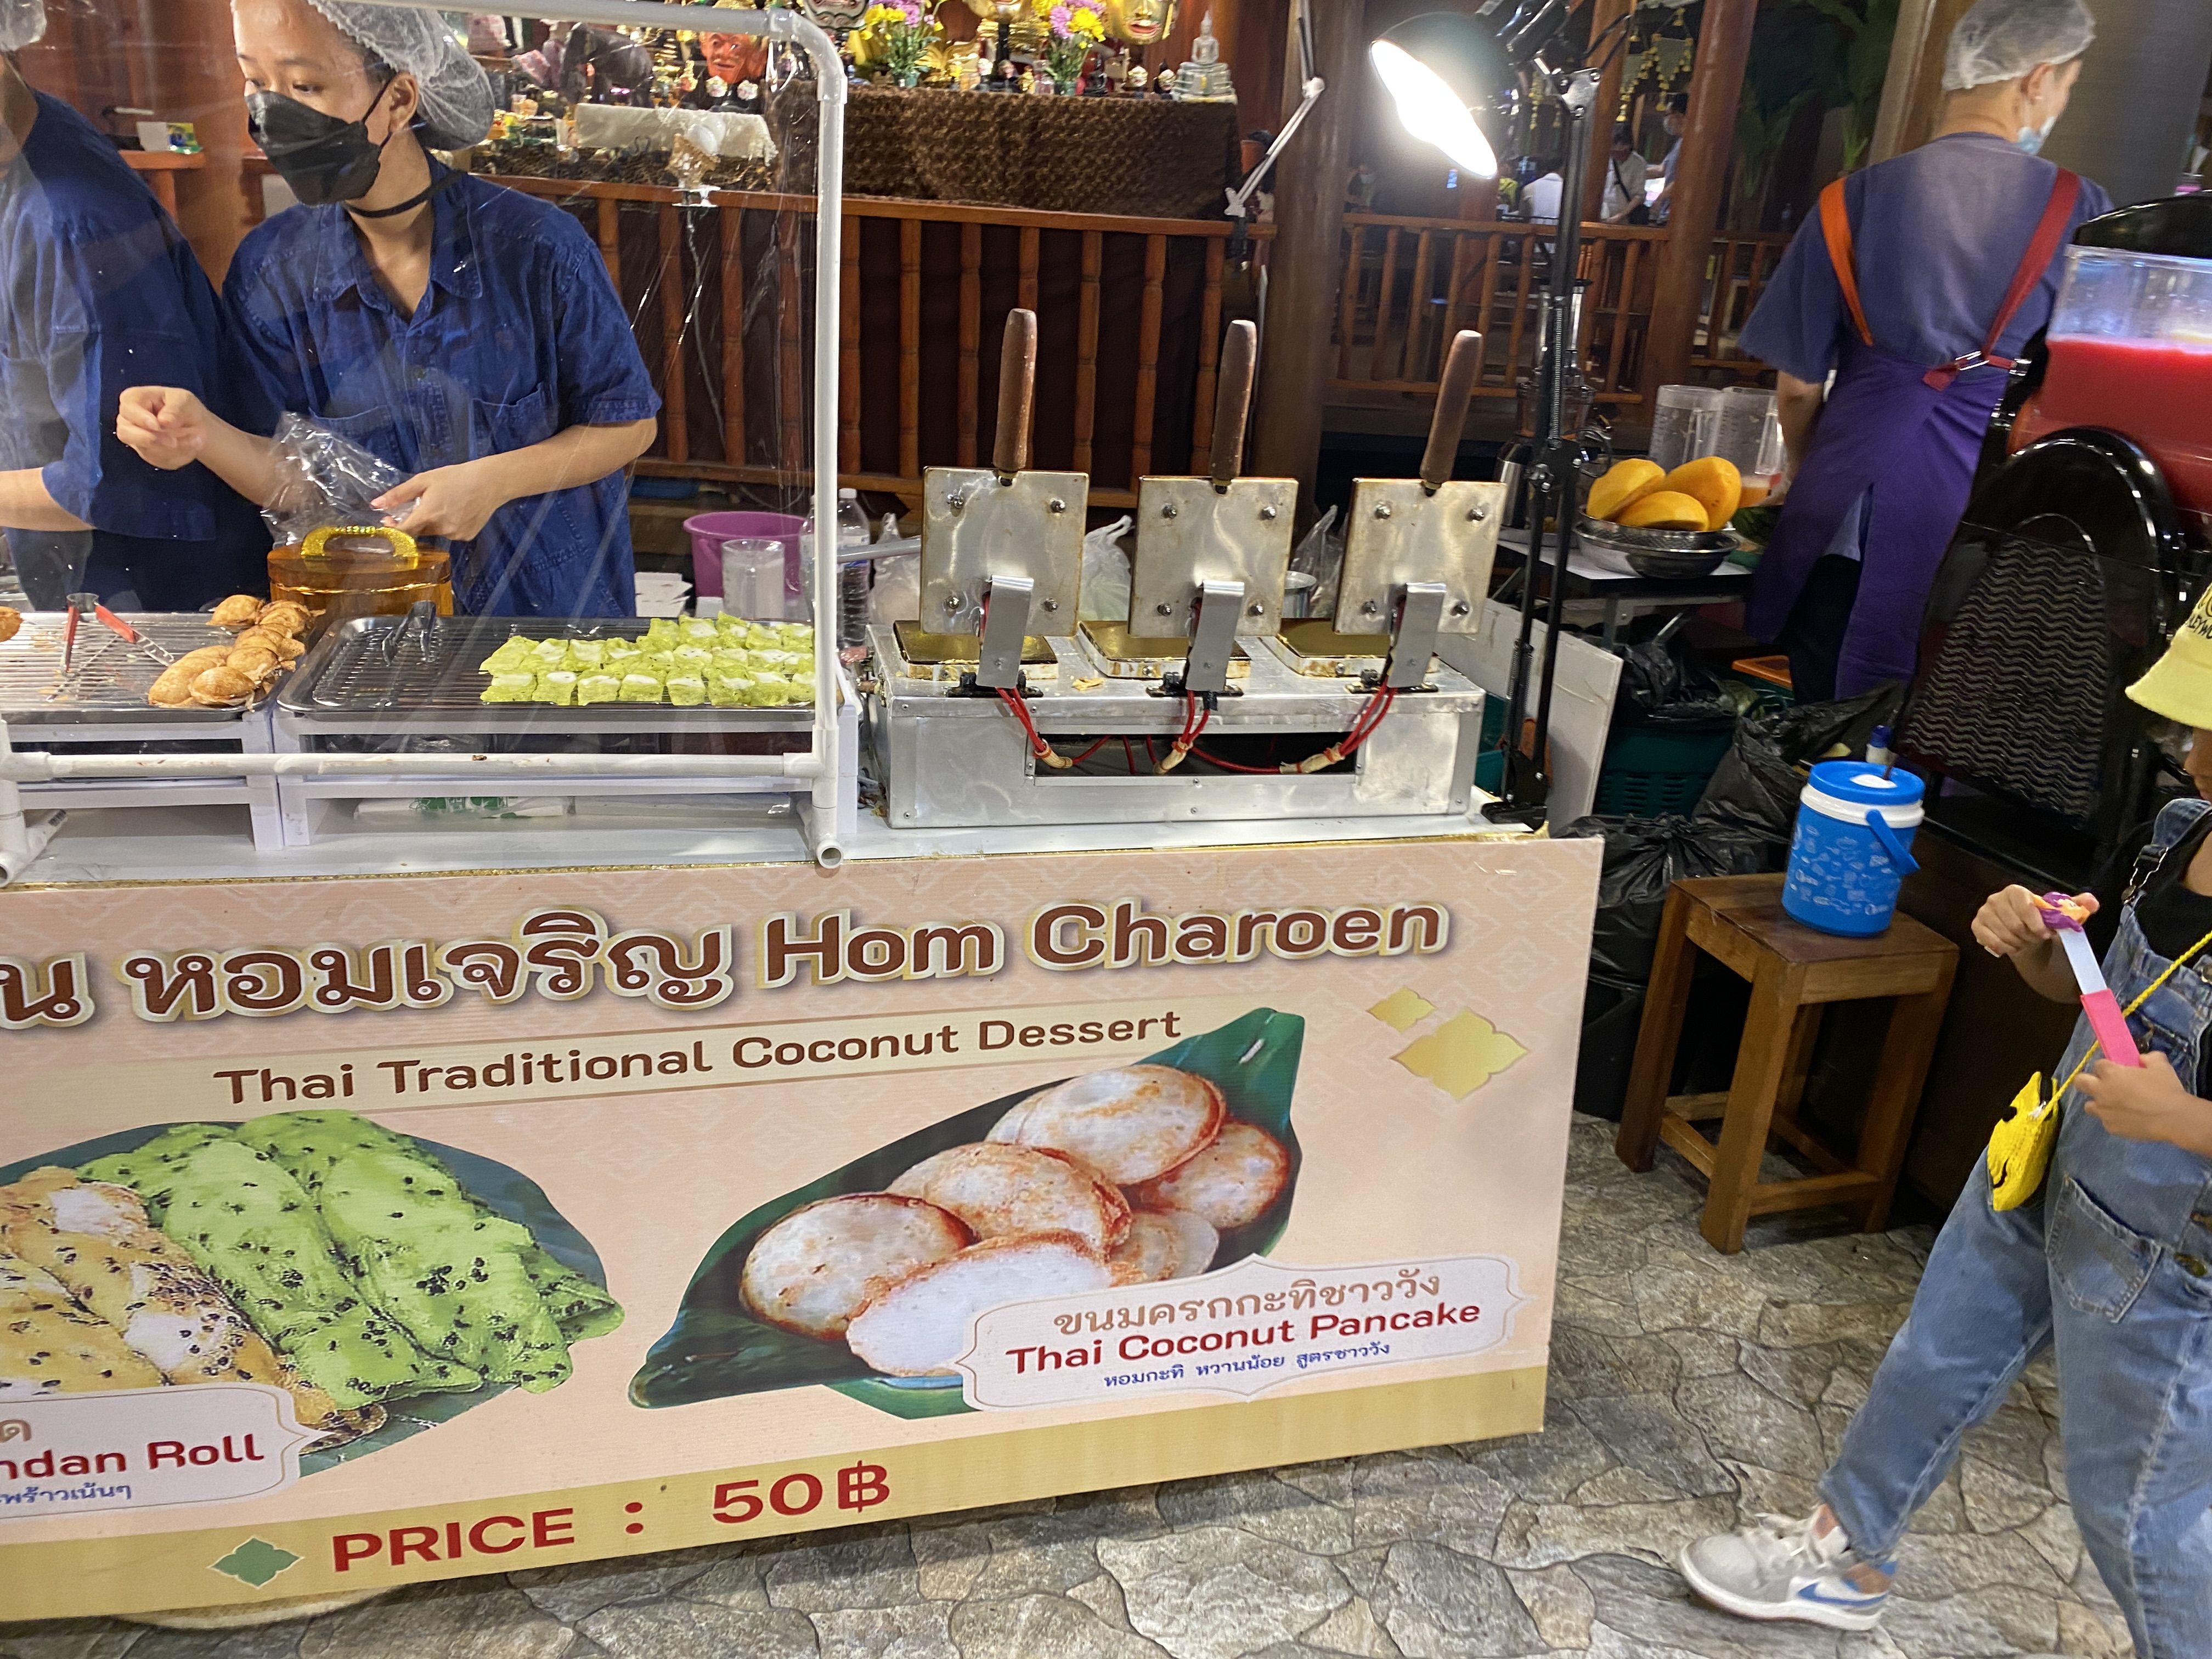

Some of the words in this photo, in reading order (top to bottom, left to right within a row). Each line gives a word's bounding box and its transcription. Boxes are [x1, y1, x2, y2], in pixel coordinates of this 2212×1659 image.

[122, 908, 726, 1018] หอมเจริญ
[764, 912, 998, 985] Hom
[1030, 900, 1443, 967] Charoen
[212, 1063, 354, 1105] Thai
[376, 1040, 714, 1094] Traditional
[732, 1024, 960, 1069] Coconut
[978, 1011, 1182, 1051] Dessert
[1006, 1339, 1102, 1374] Thai
[1118, 1320, 1294, 1361] Coconut
[1310, 1302, 1481, 1339] Pancake
[1053, 1268, 1441, 1336] ขนมครกกะทิชาววัง
[1103, 1363, 1184, 1388] หอมกะทิ
[1195, 1354, 1286, 1376] หวานน้อย
[1295, 1341, 1391, 1369] สูตรชาววัง
[147, 1432, 264, 1470] Roll
[0, 1482, 132, 1504] พร้าวเน้นๆ
[332, 1506, 575, 1573] PRICE
[624, 1501, 645, 1535] :
